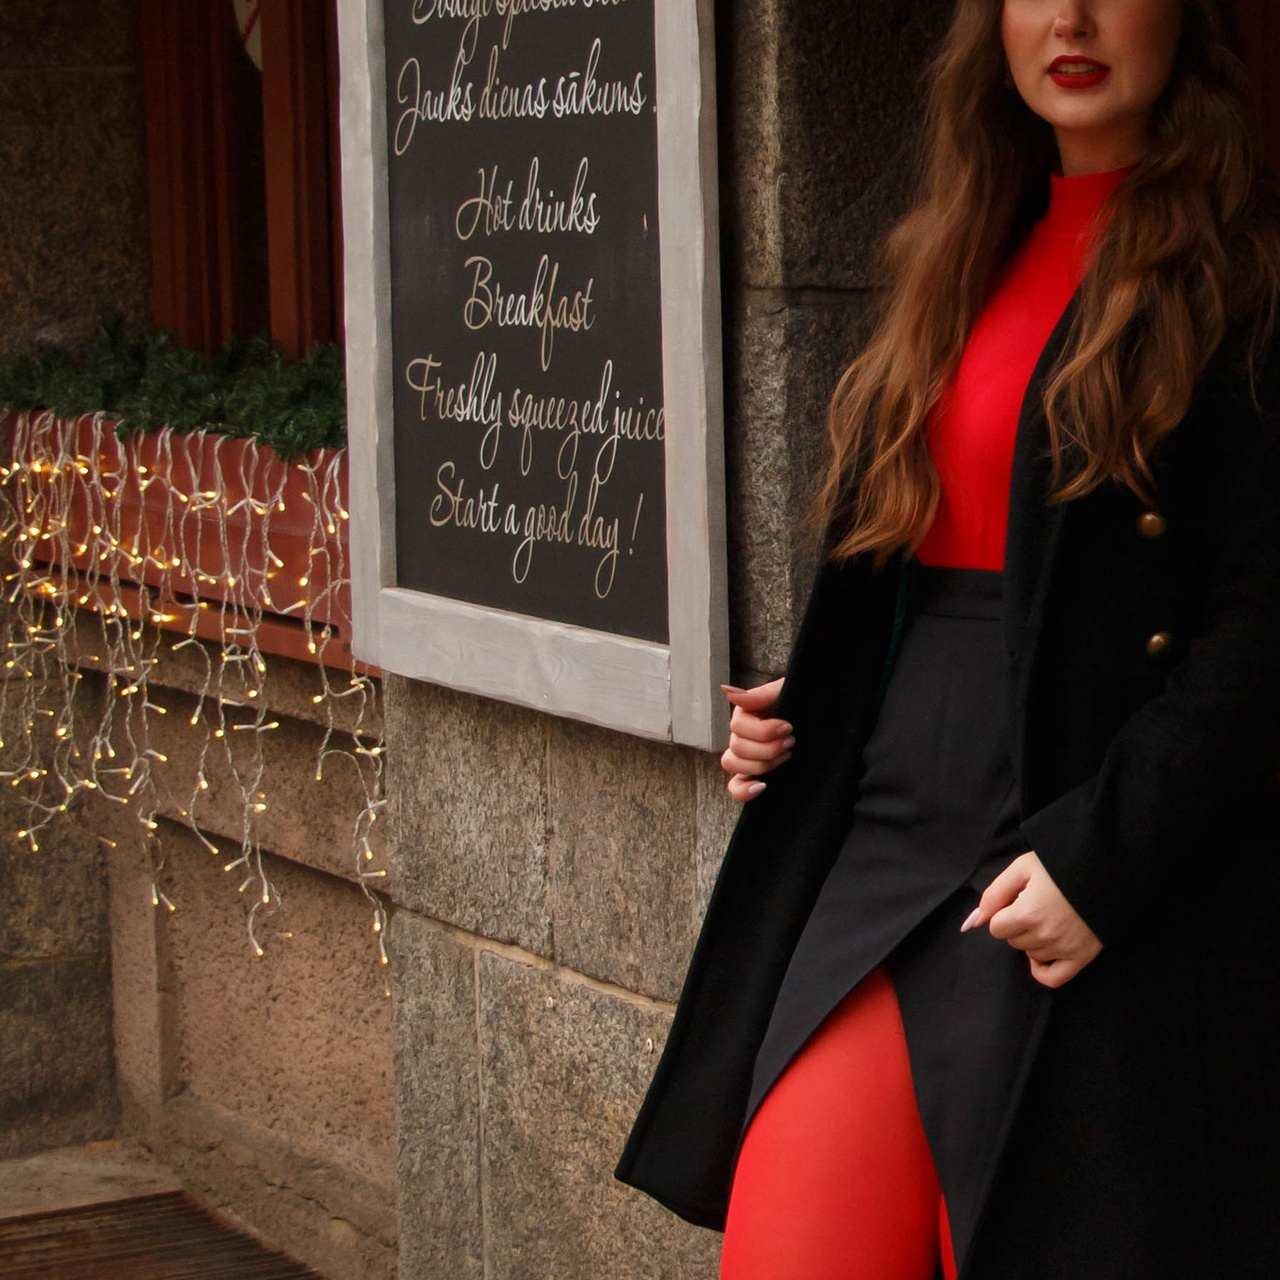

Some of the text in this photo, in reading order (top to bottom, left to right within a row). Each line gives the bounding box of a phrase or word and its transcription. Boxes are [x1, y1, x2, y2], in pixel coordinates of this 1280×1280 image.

[394, 37, 648, 156] Jauks dienas sākums
[456, 156, 601, 241] Hot drinks
[464, 254, 597, 372] Breakfast
[406, 351, 665, 484] Freshly squeezed juice
[430, 461, 502, 533] Start
[504, 503, 521, 535] a
[513, 471, 578, 584] good
